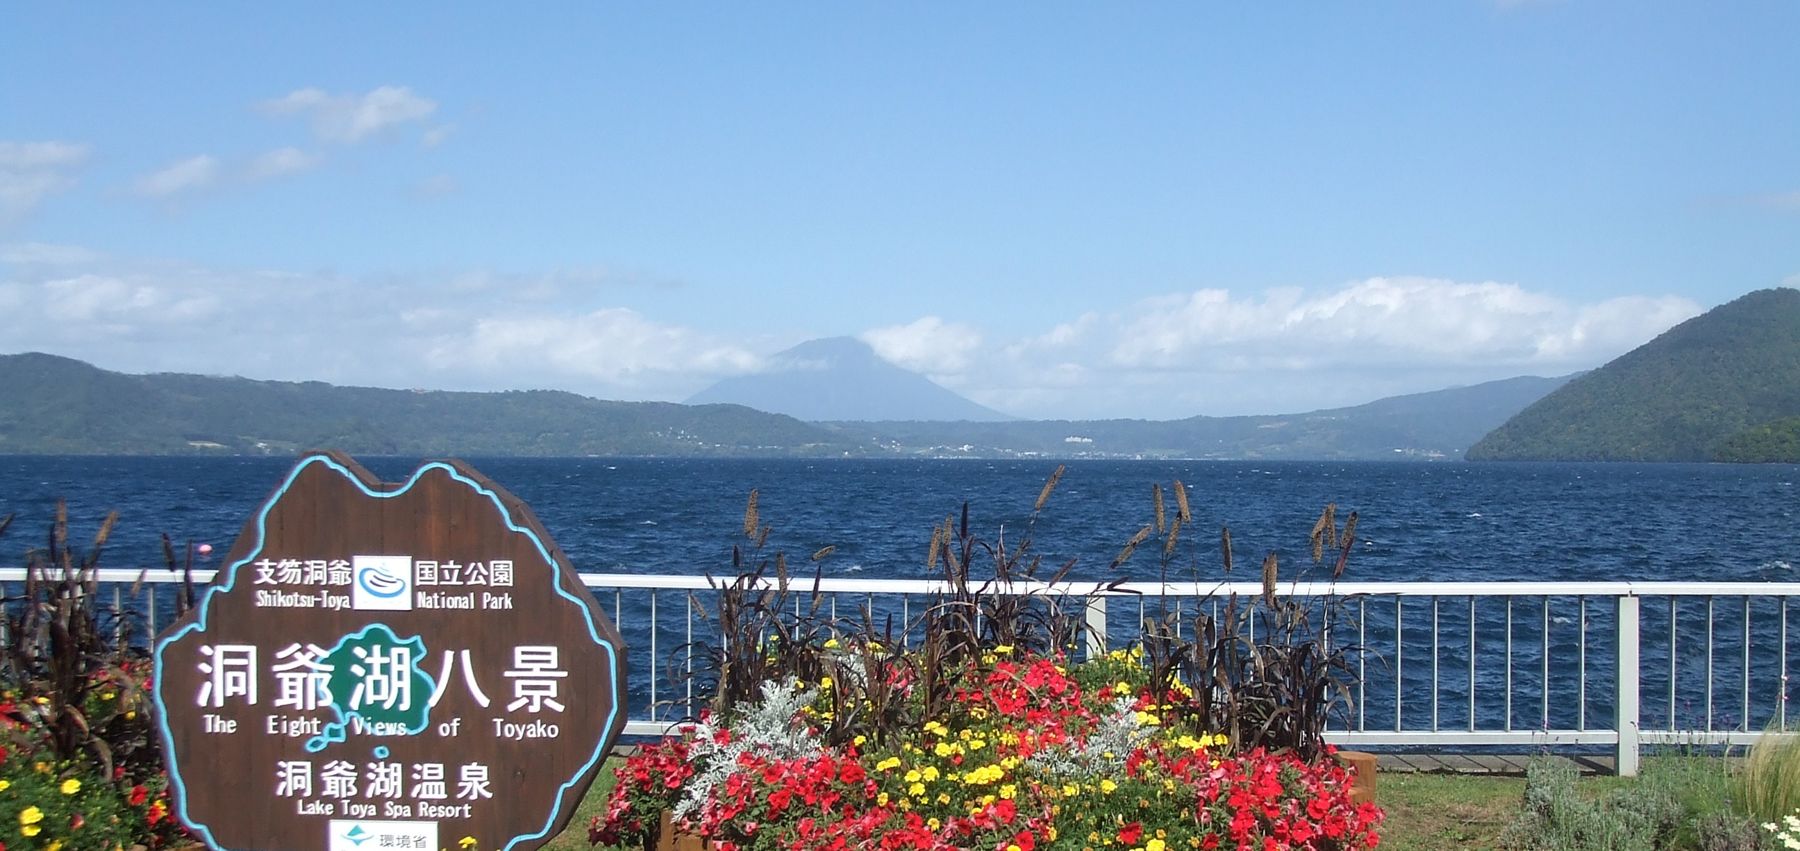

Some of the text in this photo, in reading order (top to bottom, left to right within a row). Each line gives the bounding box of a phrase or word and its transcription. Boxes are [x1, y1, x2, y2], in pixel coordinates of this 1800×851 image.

[254, 558, 514, 587] 支笏洞爺 国立公園
[256, 591, 512, 610] Shikotsu-Toya National Park
[196, 643, 568, 713] 洞爺湖八景
[204, 715, 558, 739] The Eight Views of Toyako
[276, 760, 493, 800] 洞爺湖温泉
[297, 801, 471, 819] Lake Toya Spa Resort
[379, 834, 427, 849] 環境省
